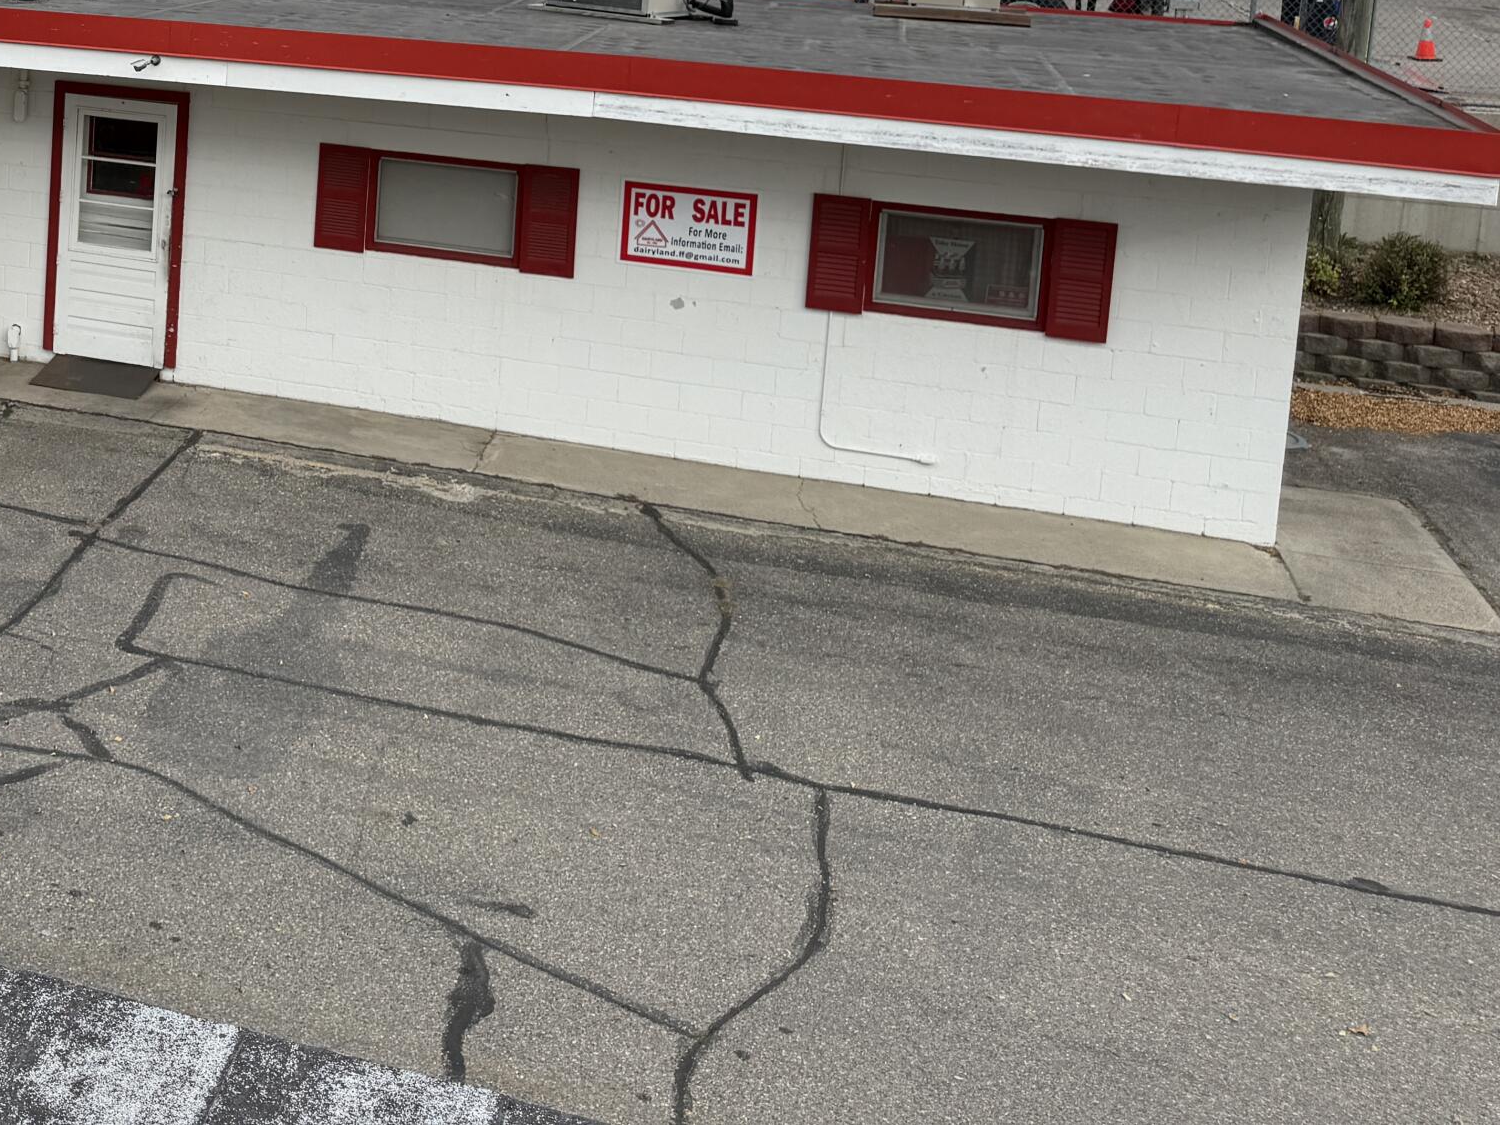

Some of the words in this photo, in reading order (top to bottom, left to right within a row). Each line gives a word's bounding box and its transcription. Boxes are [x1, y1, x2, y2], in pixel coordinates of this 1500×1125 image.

[633, 192, 676, 220] FOR
[691, 198, 747, 228] SALE
[688, 227, 703, 238] For
[704, 229, 727, 240] More
[670, 237, 717, 251] Information
[718, 243, 744, 254] Email:
